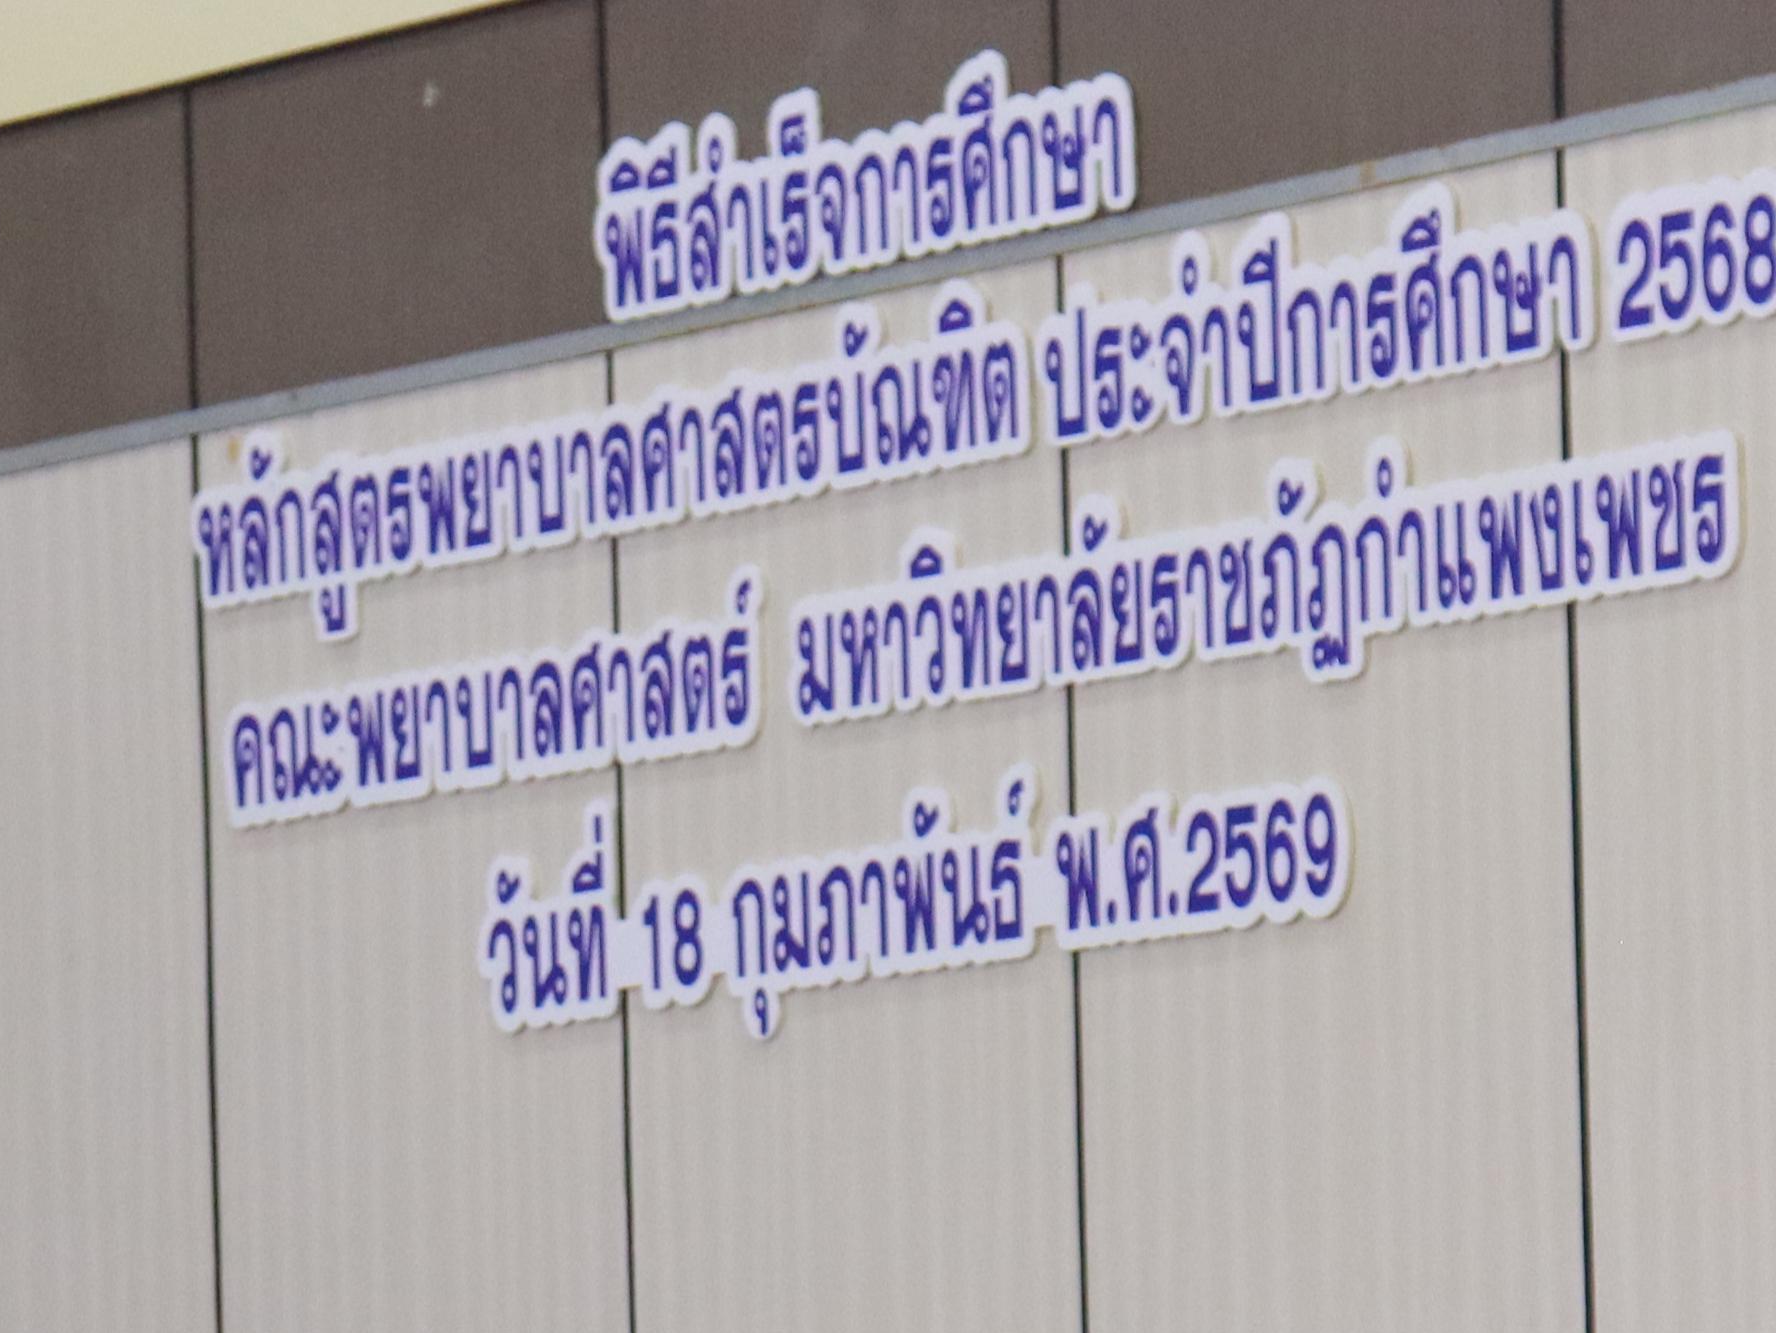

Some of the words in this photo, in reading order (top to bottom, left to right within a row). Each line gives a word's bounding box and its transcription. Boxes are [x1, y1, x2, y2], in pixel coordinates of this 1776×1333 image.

[605, 74, 1122, 309] พิธีสำเร็จการศึกษา
[198, 299, 1020, 634] หลักสูตรพยาบาลศาสตรบัณฑิต
[1044, 208, 1581, 440] ประจำปีการศึกษา
[232, 578, 752, 809] คณะพยาบาลศาสตร์
[798, 454, 1726, 717] มหาวิทยาลัยราชภัฏกำแพงเพชร
[487, 814, 608, 1016] วันที่
[642, 889, 704, 991] 18
[731, 779, 1025, 1037] กุมภาพันธ์
[1055, 794, 1337, 932] พ.ศ.2569
